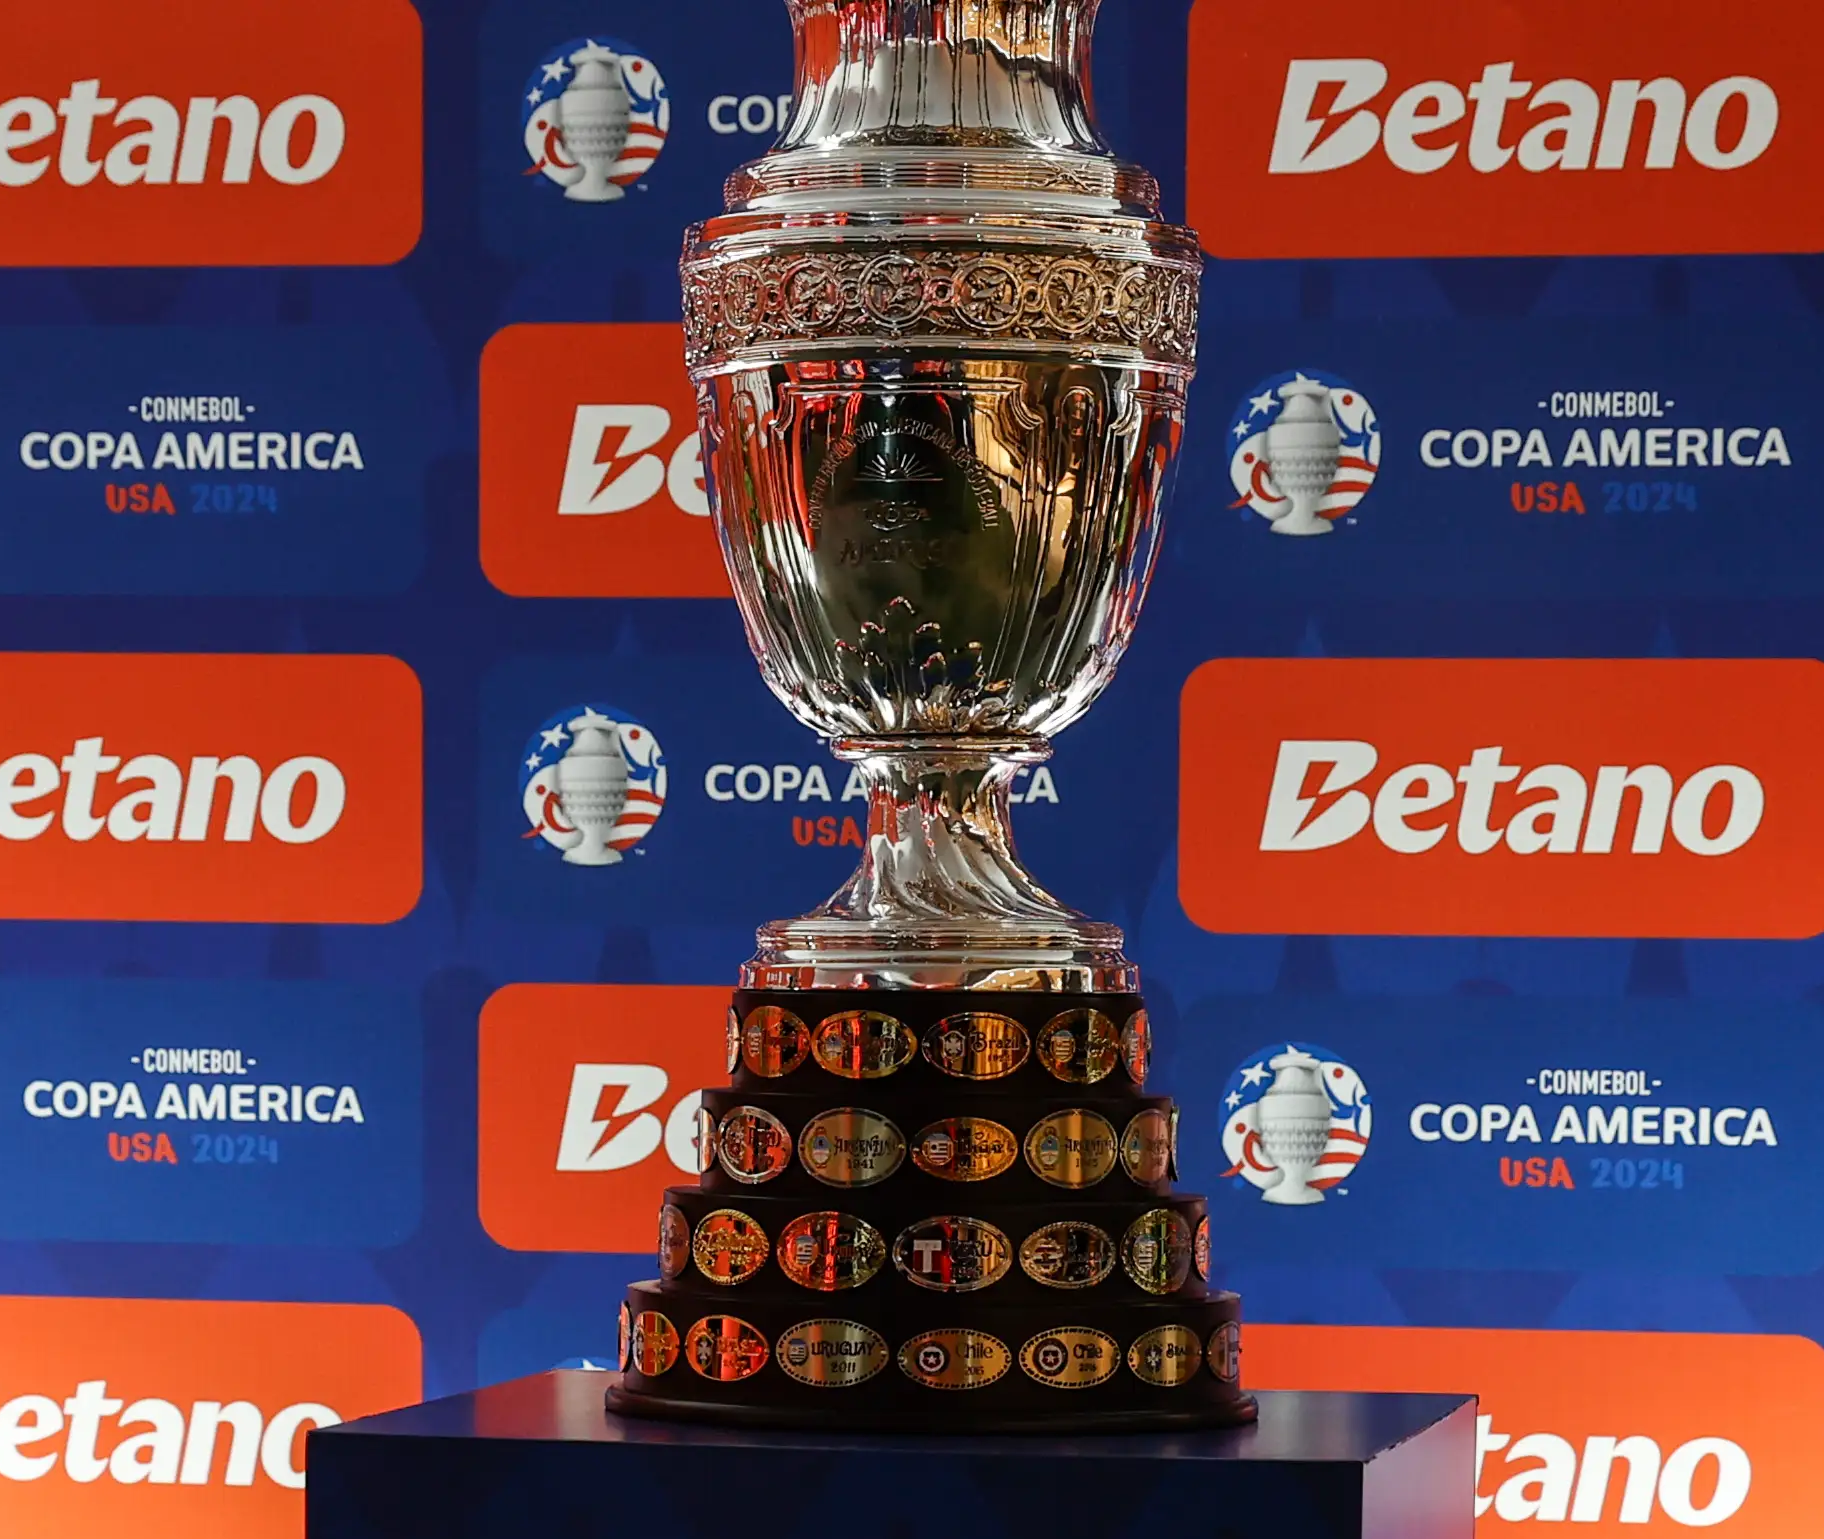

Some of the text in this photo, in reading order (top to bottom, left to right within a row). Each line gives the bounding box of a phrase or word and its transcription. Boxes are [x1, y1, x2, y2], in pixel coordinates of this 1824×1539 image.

[1269, 59, 1778, 173] Betano
[21, 432, 363, 469] COPA AMERICA
[1421, 428, 1790, 467] COPA AMERICA
[106, 483, 277, 514] USA 2024
[1512, 482, 1697, 513] USA 2024
[704, 764, 832, 802] COPA
[1260, 741, 1763, 855] Betano
[792, 816, 865, 848] USA
[24, 1081, 363, 1122] COPA AMERICA
[1411, 1104, 1777, 1145] COPA AMERICA
[109, 1133, 278, 1163] USA 2024
[1501, 1158, 1683, 1189] USA 2024
[1475, 1415, 1751, 1526] tano
